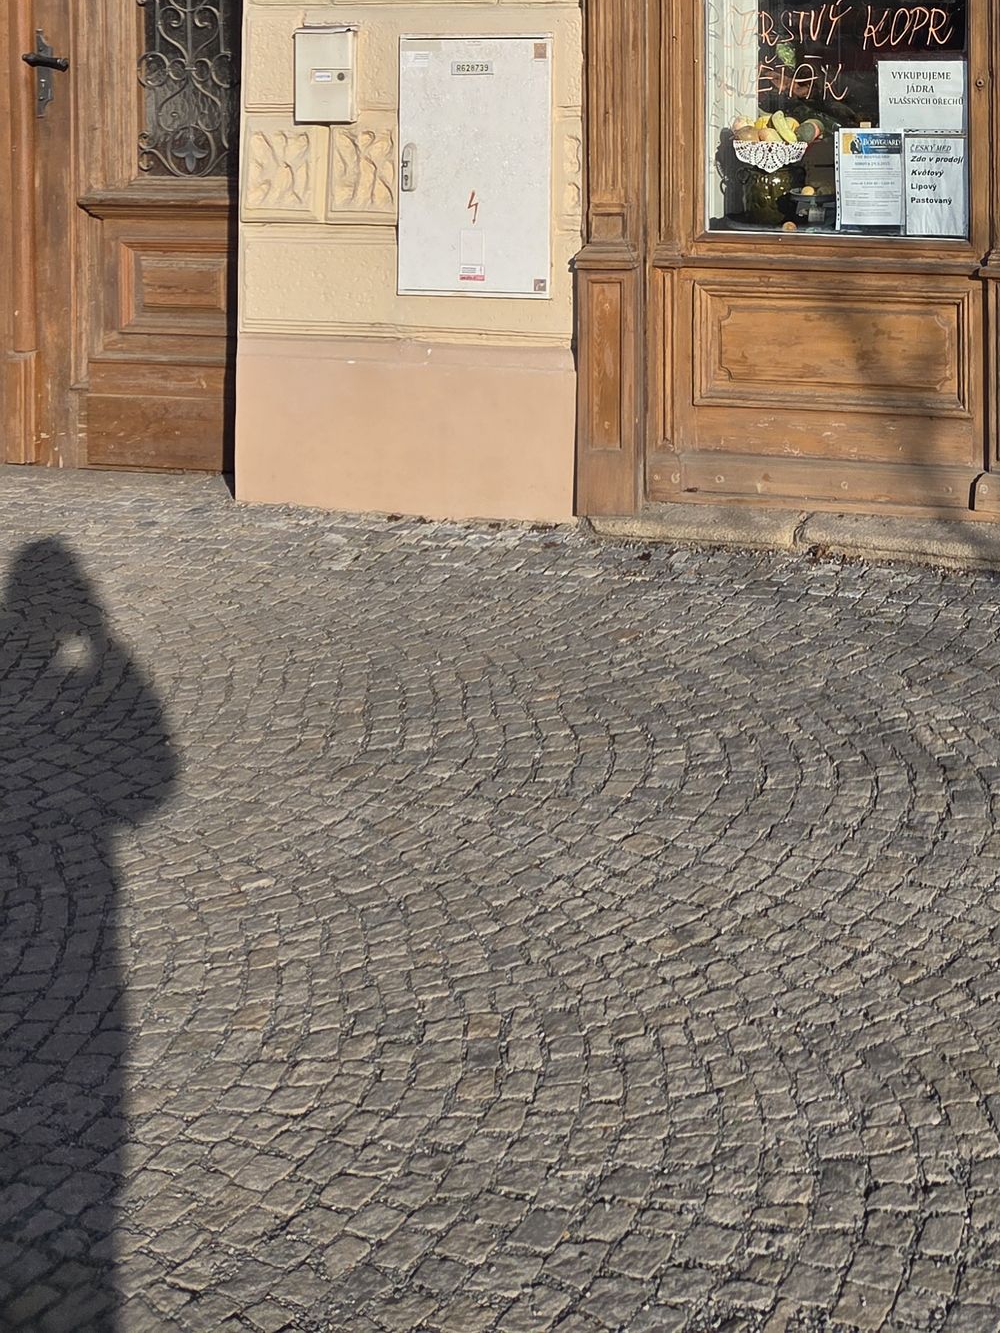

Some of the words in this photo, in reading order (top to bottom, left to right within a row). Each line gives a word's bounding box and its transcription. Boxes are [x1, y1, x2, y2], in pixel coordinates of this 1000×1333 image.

[862, 5, 954, 51] KOPR
[456, 64, 489, 72] R628739
[891, 71, 951, 81] VYKUPUJEME
[906, 83, 934, 94] JÁDRA
[888, 96, 931, 105] VLAŠSKÝCH
[863, 138, 901, 146] BODYGUARD
[910, 144, 935, 152] ČESKÝ
[936, 144, 952, 152] MED
[910, 183, 937, 191] Lipový
[910, 197, 952, 205] Pastovaný
